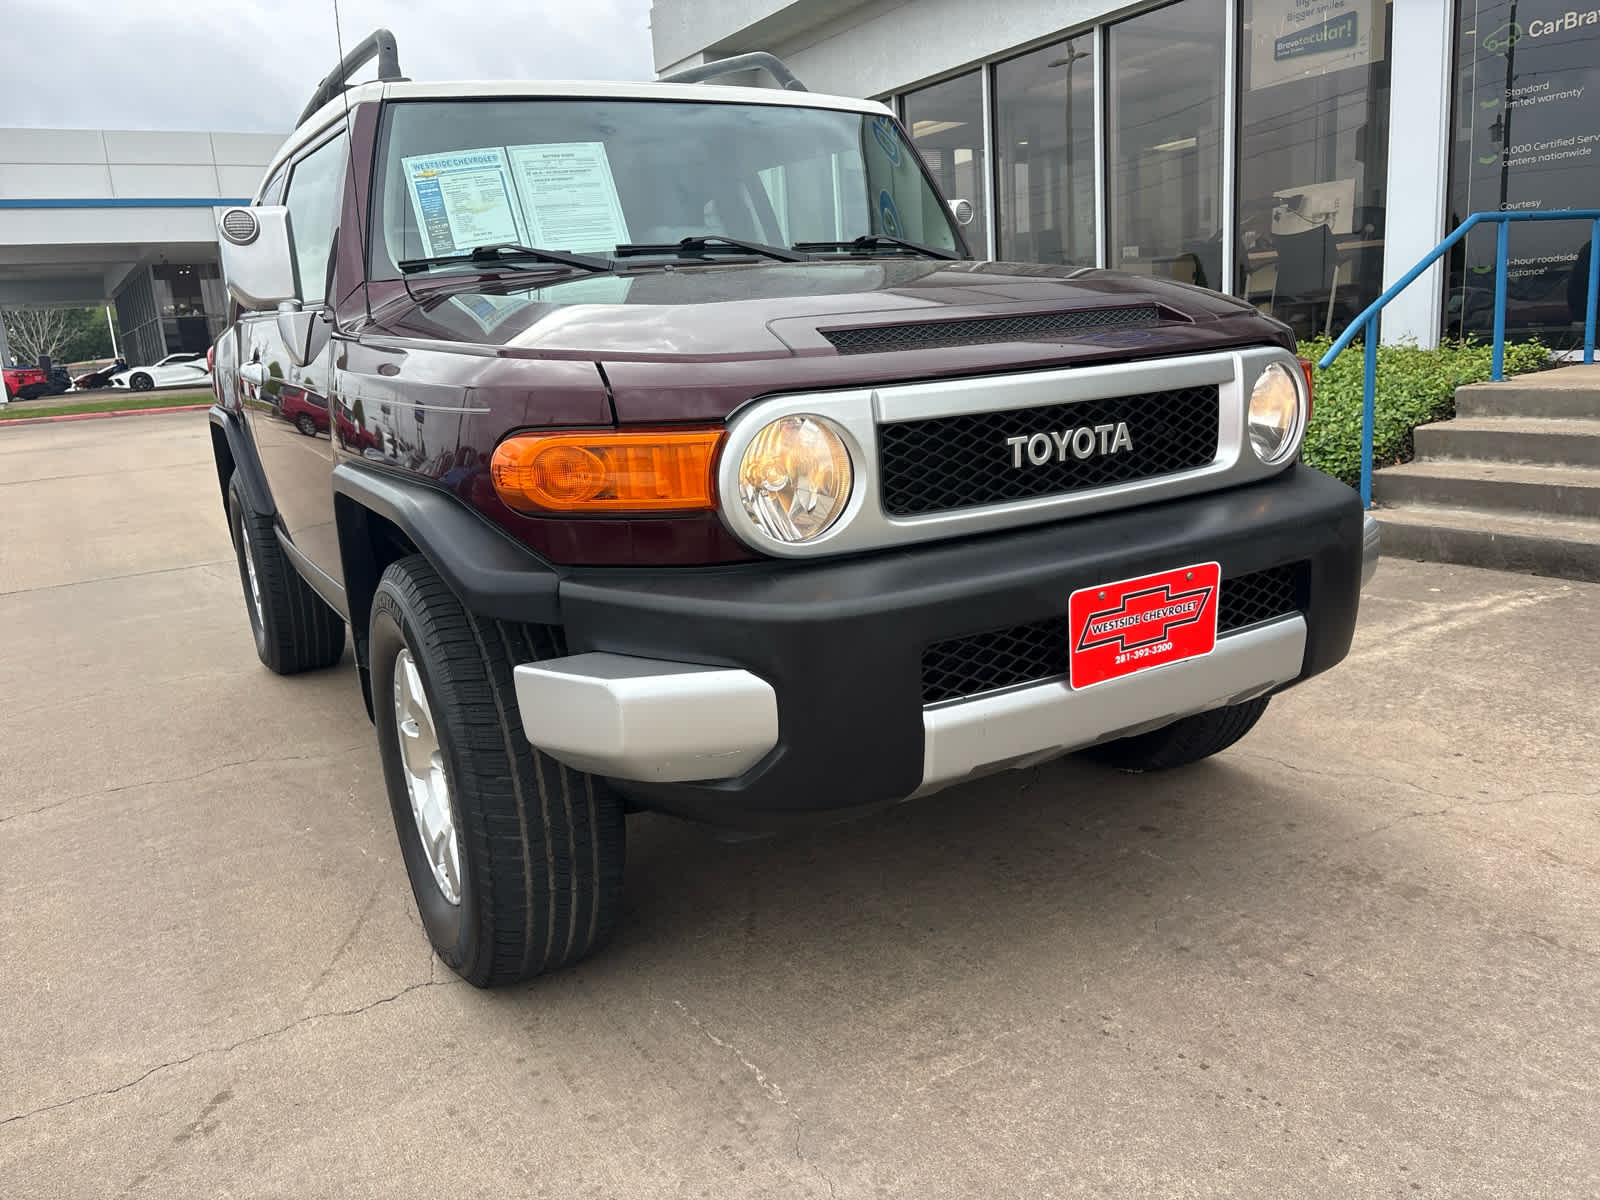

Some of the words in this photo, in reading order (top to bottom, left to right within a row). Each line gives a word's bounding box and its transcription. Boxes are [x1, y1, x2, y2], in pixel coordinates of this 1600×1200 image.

[1504, 81, 1550, 97] Standard
[1504, 95, 1536, 109] limited
[1503, 143, 1532, 155] 4,000
[1533, 137, 1575, 151] Certified
[1503, 155, 1537, 167] centers
[1538, 147, 1592, 162] nationwide
[1501, 200, 1541, 211] Courtesy
[1537, 253, 1579, 263] roadside
[1007, 422, 1134, 469] TOYOTA
[1092, 615, 1140, 635] WESTSIDE
[1142, 601, 1198, 622] CHEVROLET
[1115, 642, 1173, 664] 281-392-3200
